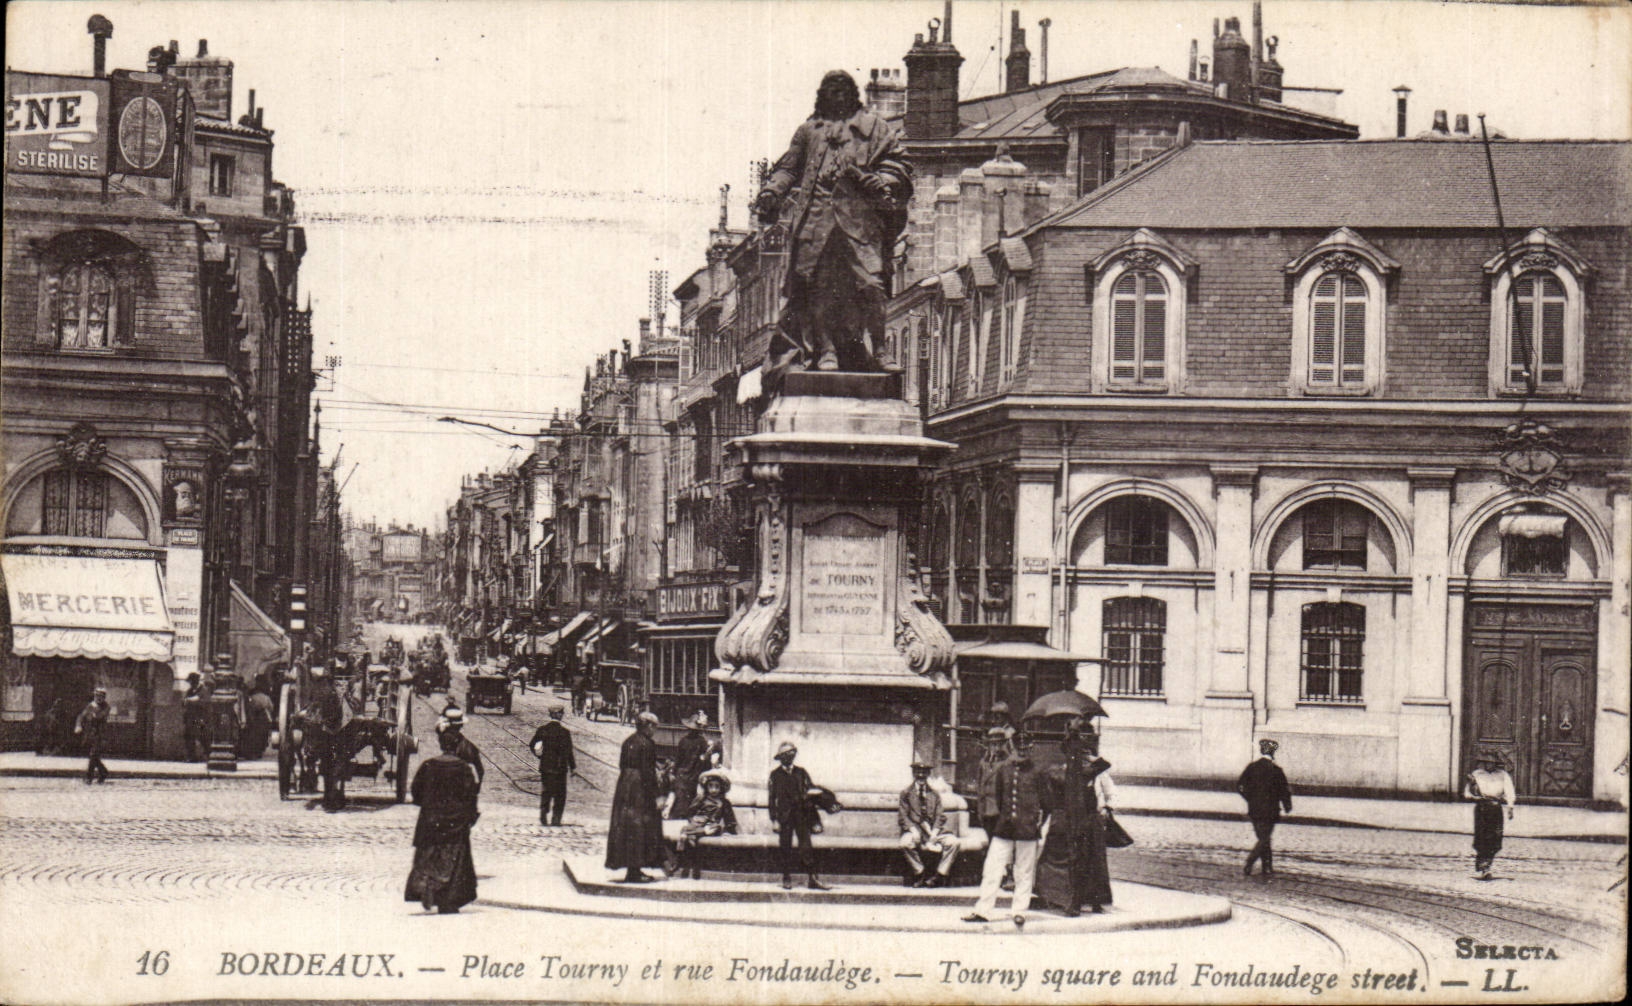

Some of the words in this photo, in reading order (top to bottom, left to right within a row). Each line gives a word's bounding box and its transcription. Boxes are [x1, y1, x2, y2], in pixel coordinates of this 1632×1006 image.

[826, 573, 874, 587] TOURNY
[17, 590, 157, 616] MERCERIE
[660, 585, 697, 614] BIJOUX
